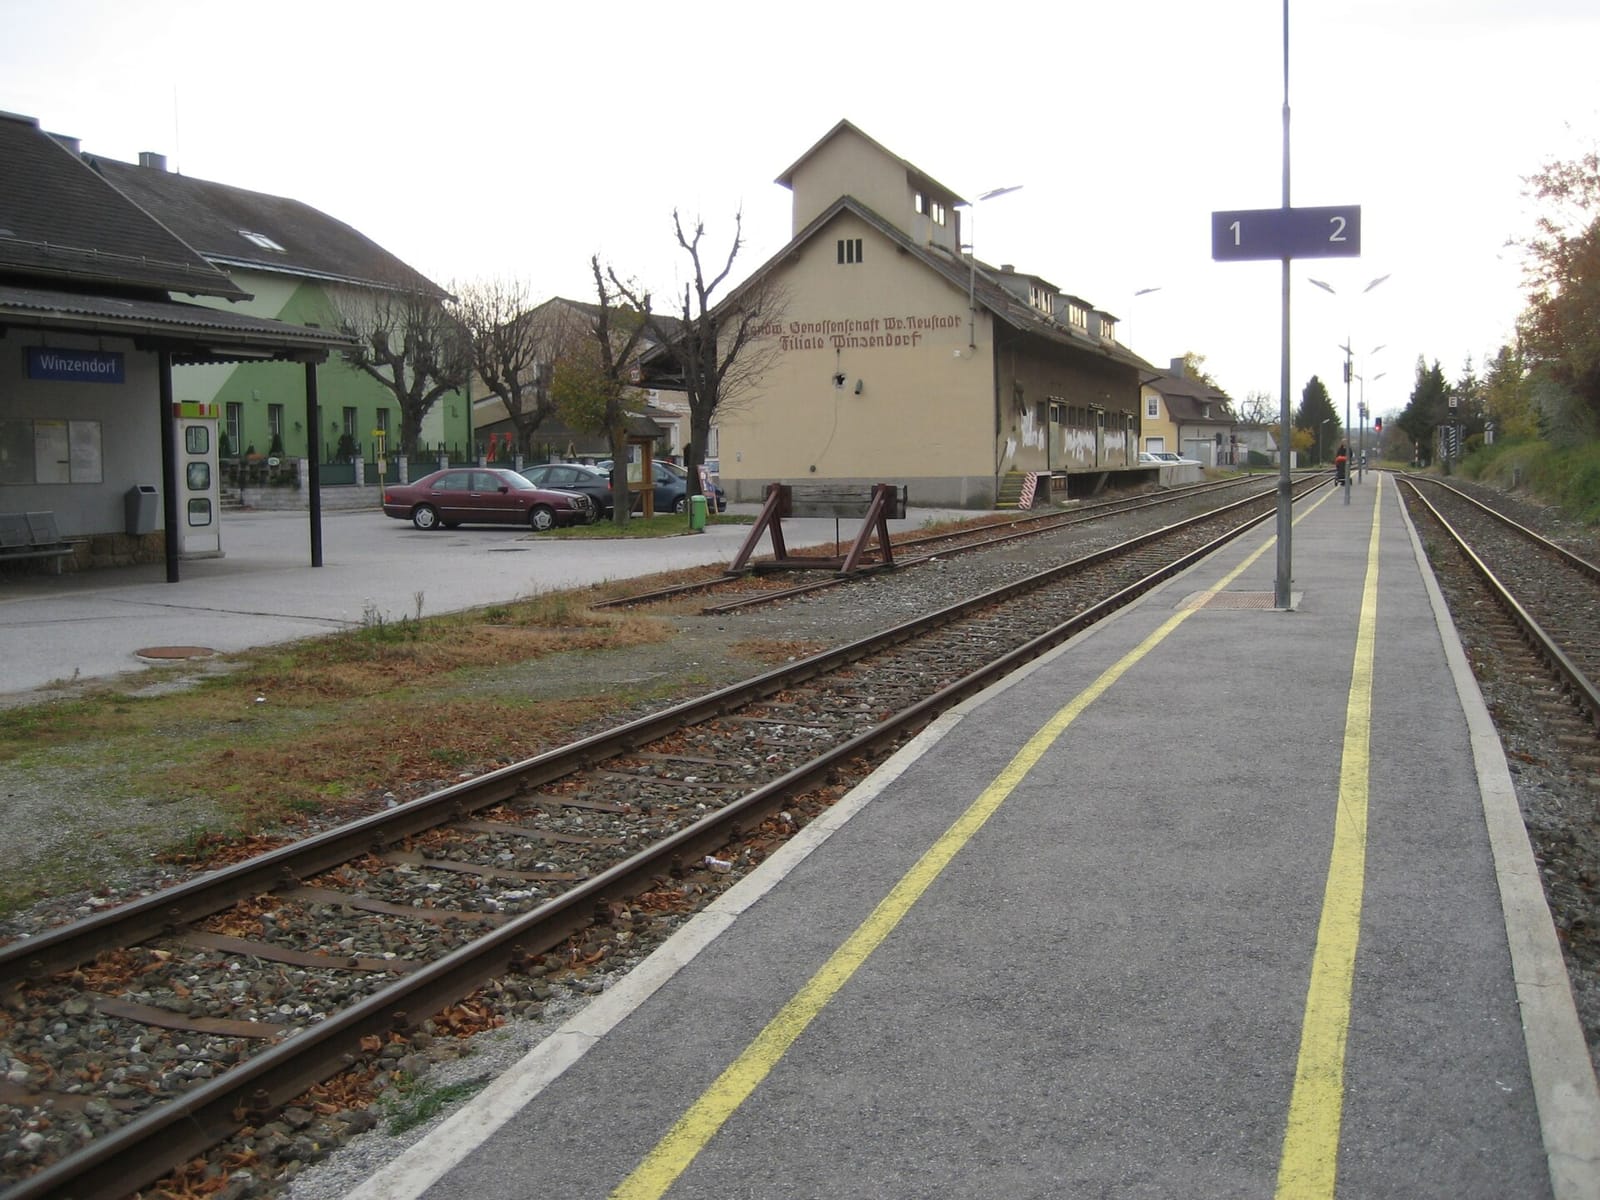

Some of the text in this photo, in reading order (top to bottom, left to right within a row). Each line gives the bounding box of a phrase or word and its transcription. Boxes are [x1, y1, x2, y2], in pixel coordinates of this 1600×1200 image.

[1229, 216, 1347, 246] 1 2
[906, 315, 961, 331] Neustadt
[779, 331, 922, 351] Filiale Winzendorf
[40, 354, 116, 374] Winzendorf
